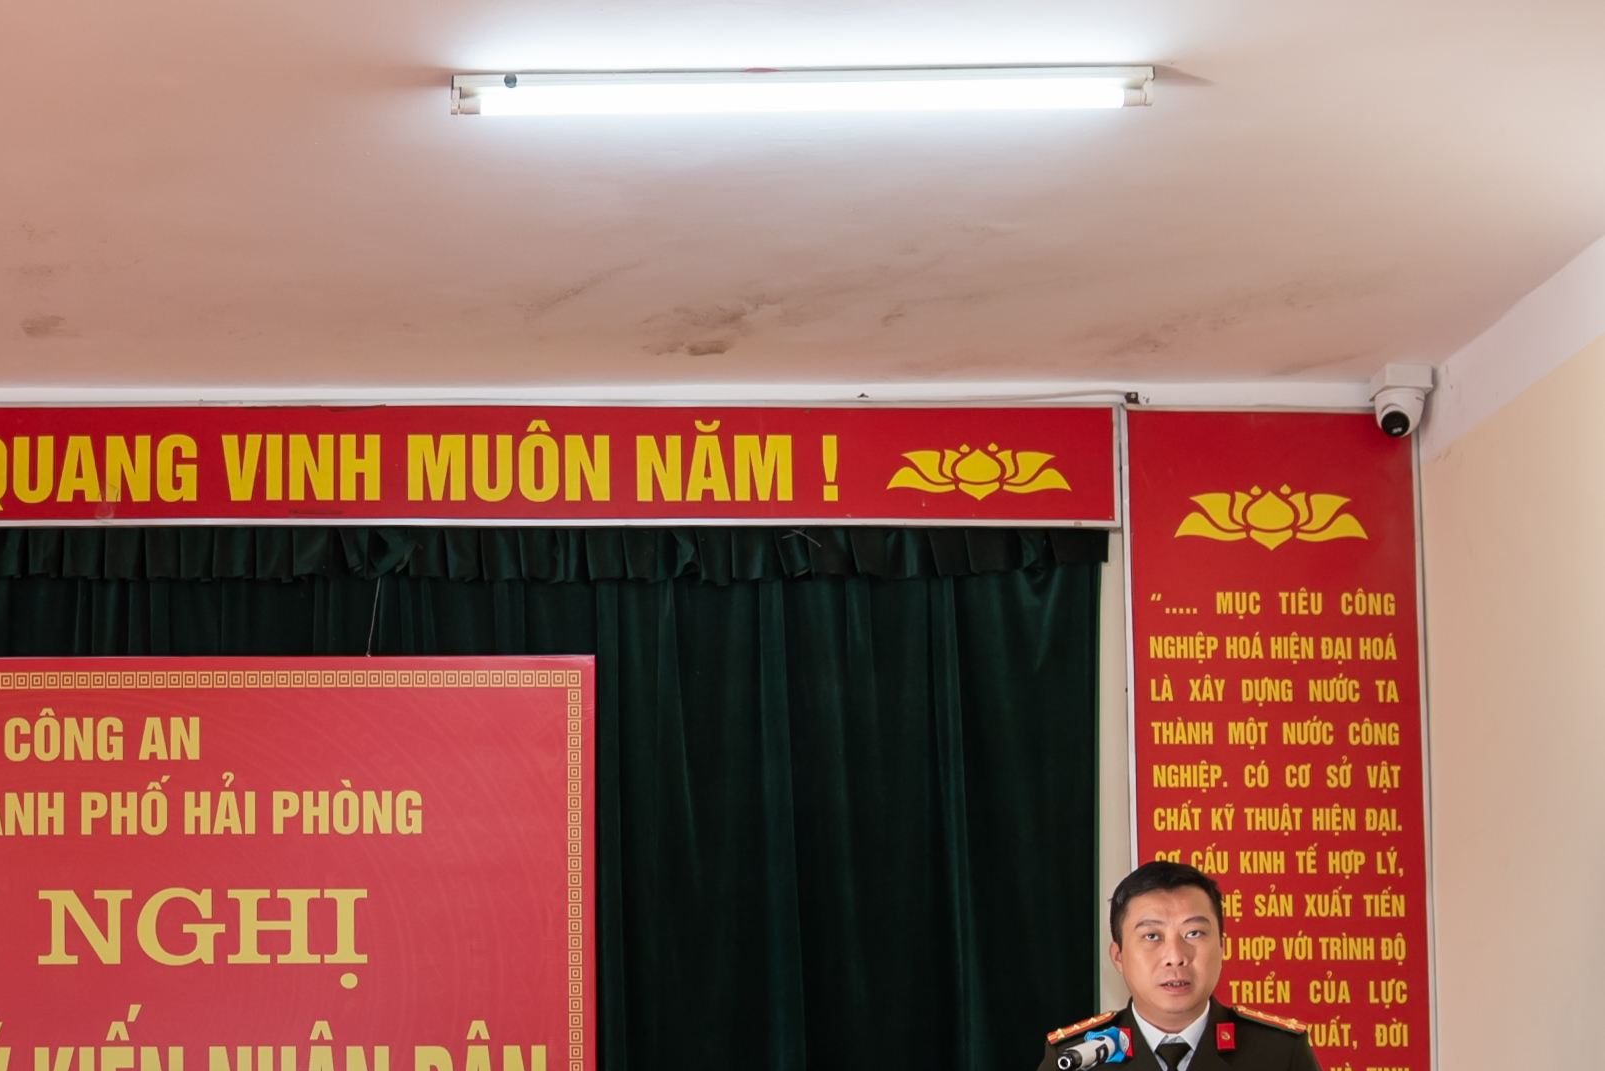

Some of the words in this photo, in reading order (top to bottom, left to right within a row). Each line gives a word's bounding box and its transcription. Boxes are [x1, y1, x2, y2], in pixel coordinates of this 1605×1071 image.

[221, 433, 381, 502] VINH
[407, 419, 611, 503] MUÔN
[635, 419, 794, 502] NĂM
[822, 434, 839, 502] !
[1215, 591, 1261, 620] MỤC
[1278, 587, 1323, 616] TIÊU
[1340, 587, 1396, 616] CÔNG
[1149, 631, 1219, 665] NGHIỆP
[1225, 631, 1264, 660] HOÁ
[1270, 631, 1315, 665] HIỆN
[1320, 636, 1353, 665] ĐẠI
[1359, 632, 1397, 661] HOÁ
[1150, 673, 1174, 702] LÀ
[1188, 673, 1226, 702] XÂY
[1241, 676, 1294, 707] DỰNG
[1308, 672, 1361, 703] NƯỚC
[1374, 679, 1400, 703] TA
[4, 707, 124, 762] CÔNG
[138, 716, 201, 761] AN
[1152, 759, 1228, 793] NGHIỆP.
[1243, 759, 1270, 789] CÓ
[1285, 763, 1312, 788] CƠ
[1326, 755, 1353, 789] SỞ
[1366, 760, 1401, 794] VẬT
[80, 775, 171, 836] PHỐ
[183, 771, 256, 835] HẢI
[272, 778, 423, 836] PHÒNG
[1153, 799, 1202, 832] CHẤT
[1210, 803, 1236, 831] KỸ
[1243, 802, 1303, 836] THUẬT
[1311, 803, 1356, 836] HIỆN
[1364, 808, 1403, 837] ĐẠI.
[1190, 842, 1229, 875] CẤU
[1239, 850, 1286, 874] KINH
[1295, 842, 1318, 874] TẾ
[1328, 849, 1366, 880] HỢP
[1376, 846, 1404, 877] LÝ,
[1254, 883, 1294, 918] SẢN
[1304, 885, 1353, 918] XUẤT
[1362, 886, 1406, 918] TIẾN
[37, 887, 369, 990] NGHỊ
[1238, 935, 1277, 966] HỢP
[1282, 930, 1313, 961] VỚI
[1318, 932, 1375, 961] TRÌNH
[1380, 932, 1407, 966] ĐỘ
[1228, 971, 1291, 1004] TRIỂN
[1309, 970, 1351, 1004] CỦA
[1369, 978, 1408, 1009] LỰC
[1374, 1017, 1409, 1047] ĐỜI
